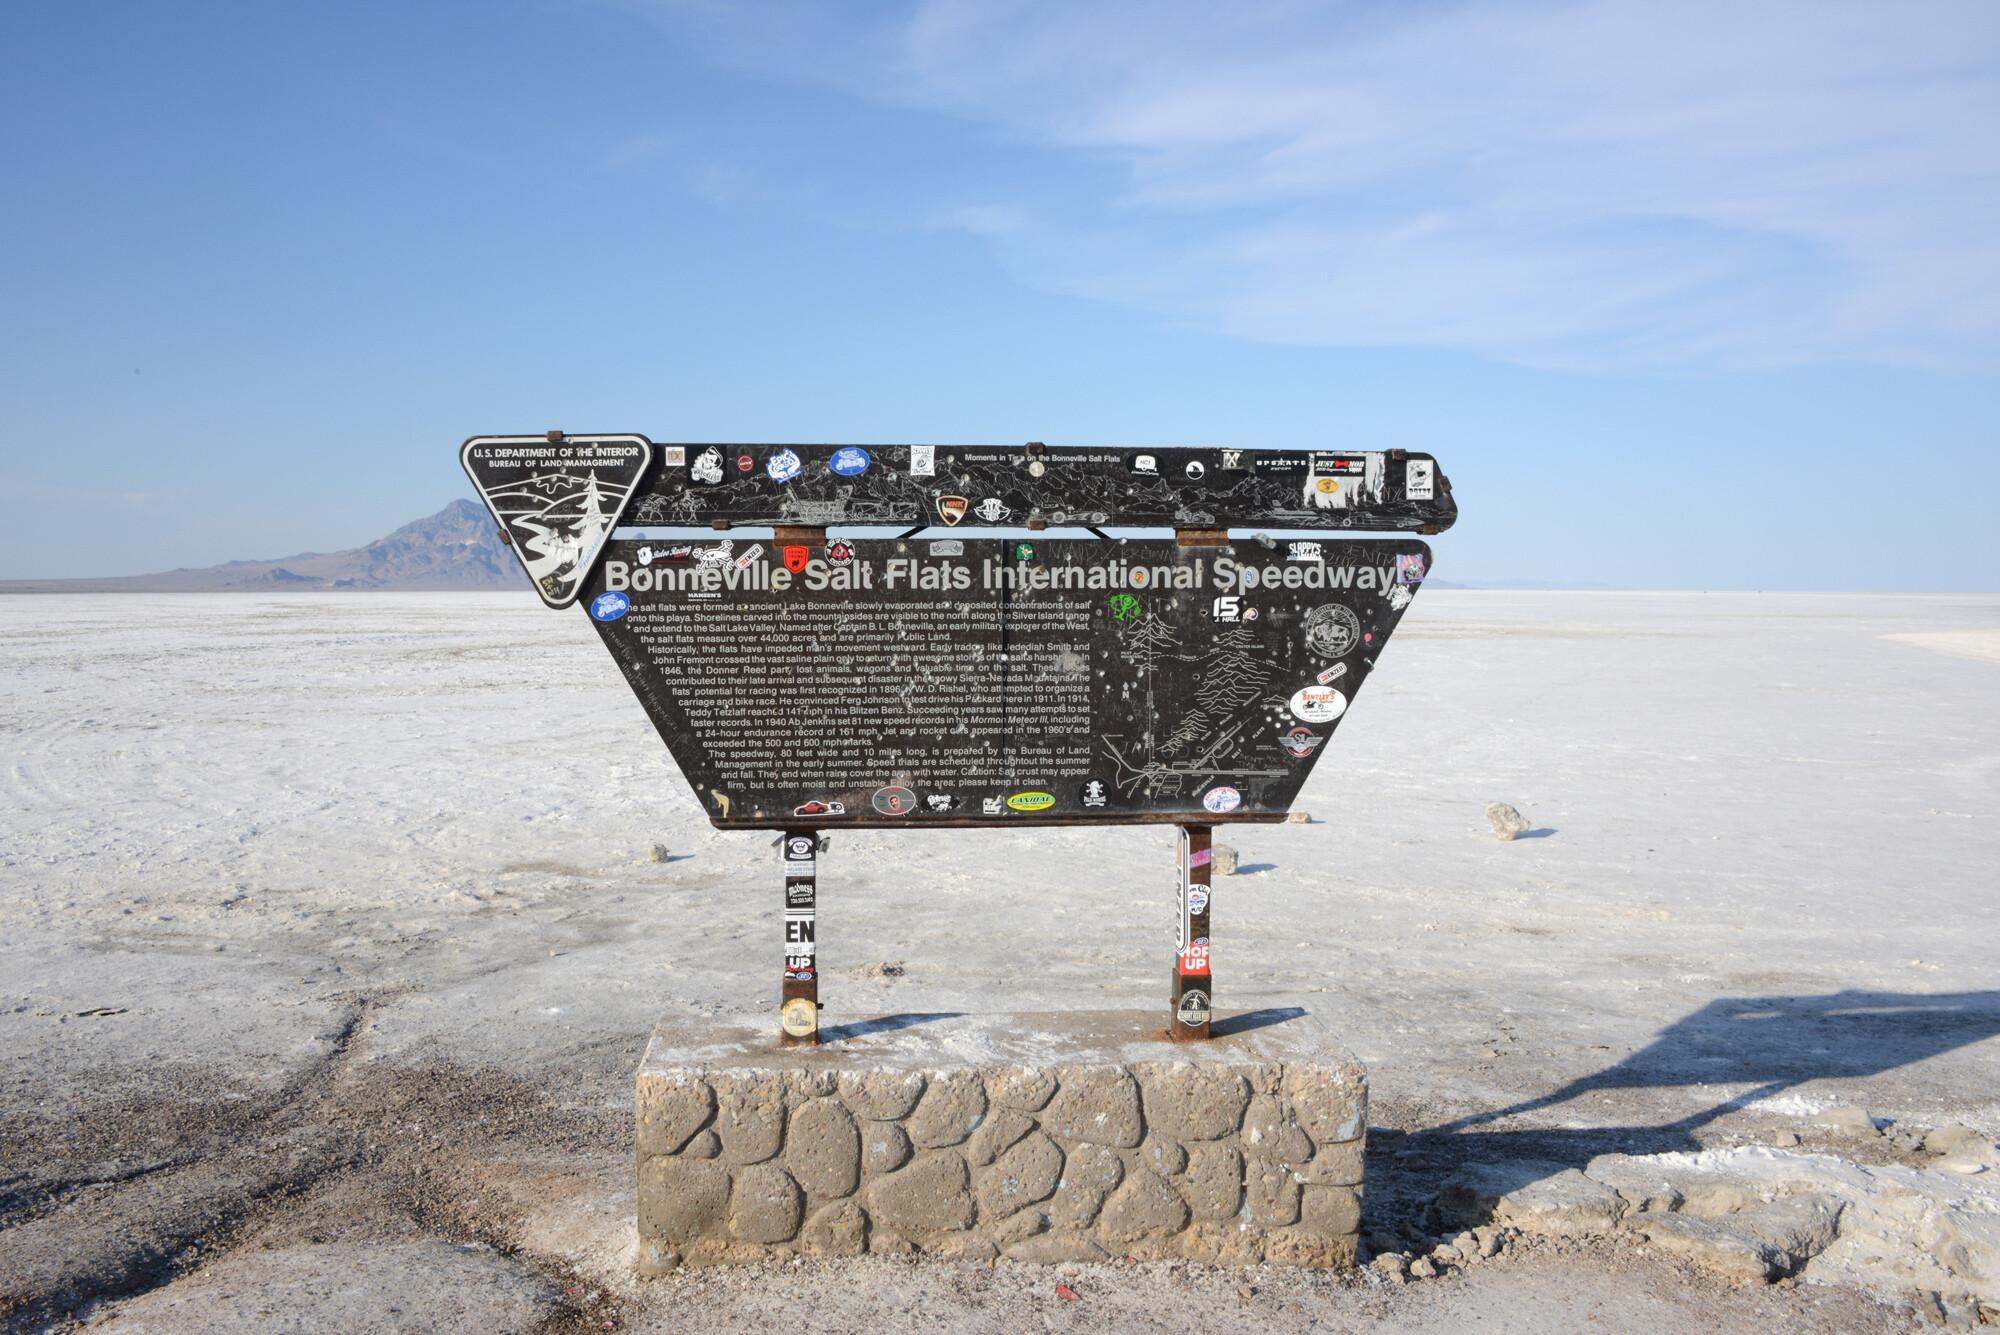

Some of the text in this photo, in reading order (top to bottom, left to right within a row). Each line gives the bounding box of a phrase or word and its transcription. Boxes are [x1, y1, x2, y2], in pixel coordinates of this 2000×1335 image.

[474, 447, 638, 458] U. S. DEPARTMENT OF THE INTERIOR
[1008, 454, 1024, 462] Tie
[540, 459, 562, 467] LAND
[566, 459, 624, 467] MANAGEMENT
[605, 557, 1396, 596] Bonneville Salt Flats International Speedway
[641, 601, 933, 612] salt flats formed ancient Bonneville slowly evaporated
[1213, 596, 1240, 616] 15
[628, 611, 1064, 624] onto playa. Shorelines carved visible along Silver Island
[652, 621, 1090, 634] extend Valley. Named after early West,
[676, 634, 694, 643] flats
[761, 633, 789, 644] 44,000
[857, 633, 894, 643] primarily
[648, 643, 952, 655] Historically, flats have impeded movement westward. Early
[677, 654, 834, 664] Fremont crossed saline plain
[706, 664, 890, 675] Donner Reed animals, wagons
[666, 674, 902, 685] contributed their arrival disaster
[672, 683, 1083, 697] flats' potential racing first recognized Rishel, organize
[678, 694, 1056, 707] carriage bike convinced Johnson drive 1911.
[685, 705, 984, 718] Teddy Blitzen Succeeding years
[691, 715, 1090, 727] faster records. 1940 Jenkins speed records Meteor including
[706, 726, 947, 737] 24-hour endurance record rocket
[702, 739, 745, 748] exceeded
[731, 745, 1090, 759] speedway, Bureau Land
[715, 759, 772, 770] Management
[803, 758, 824, 769] early
[898, 758, 919, 766] trials
[940, 757, 984, 766] scheduled
[933, 768, 958, 776] water.
[1017, 767, 1038, 775] crust
[1060, 768, 1090, 777] appear
[778, 777, 1048, 788] often moist unstable. please clean.
[789, 958, 811, 968] UP
[1185, 959, 1206, 970] UP
